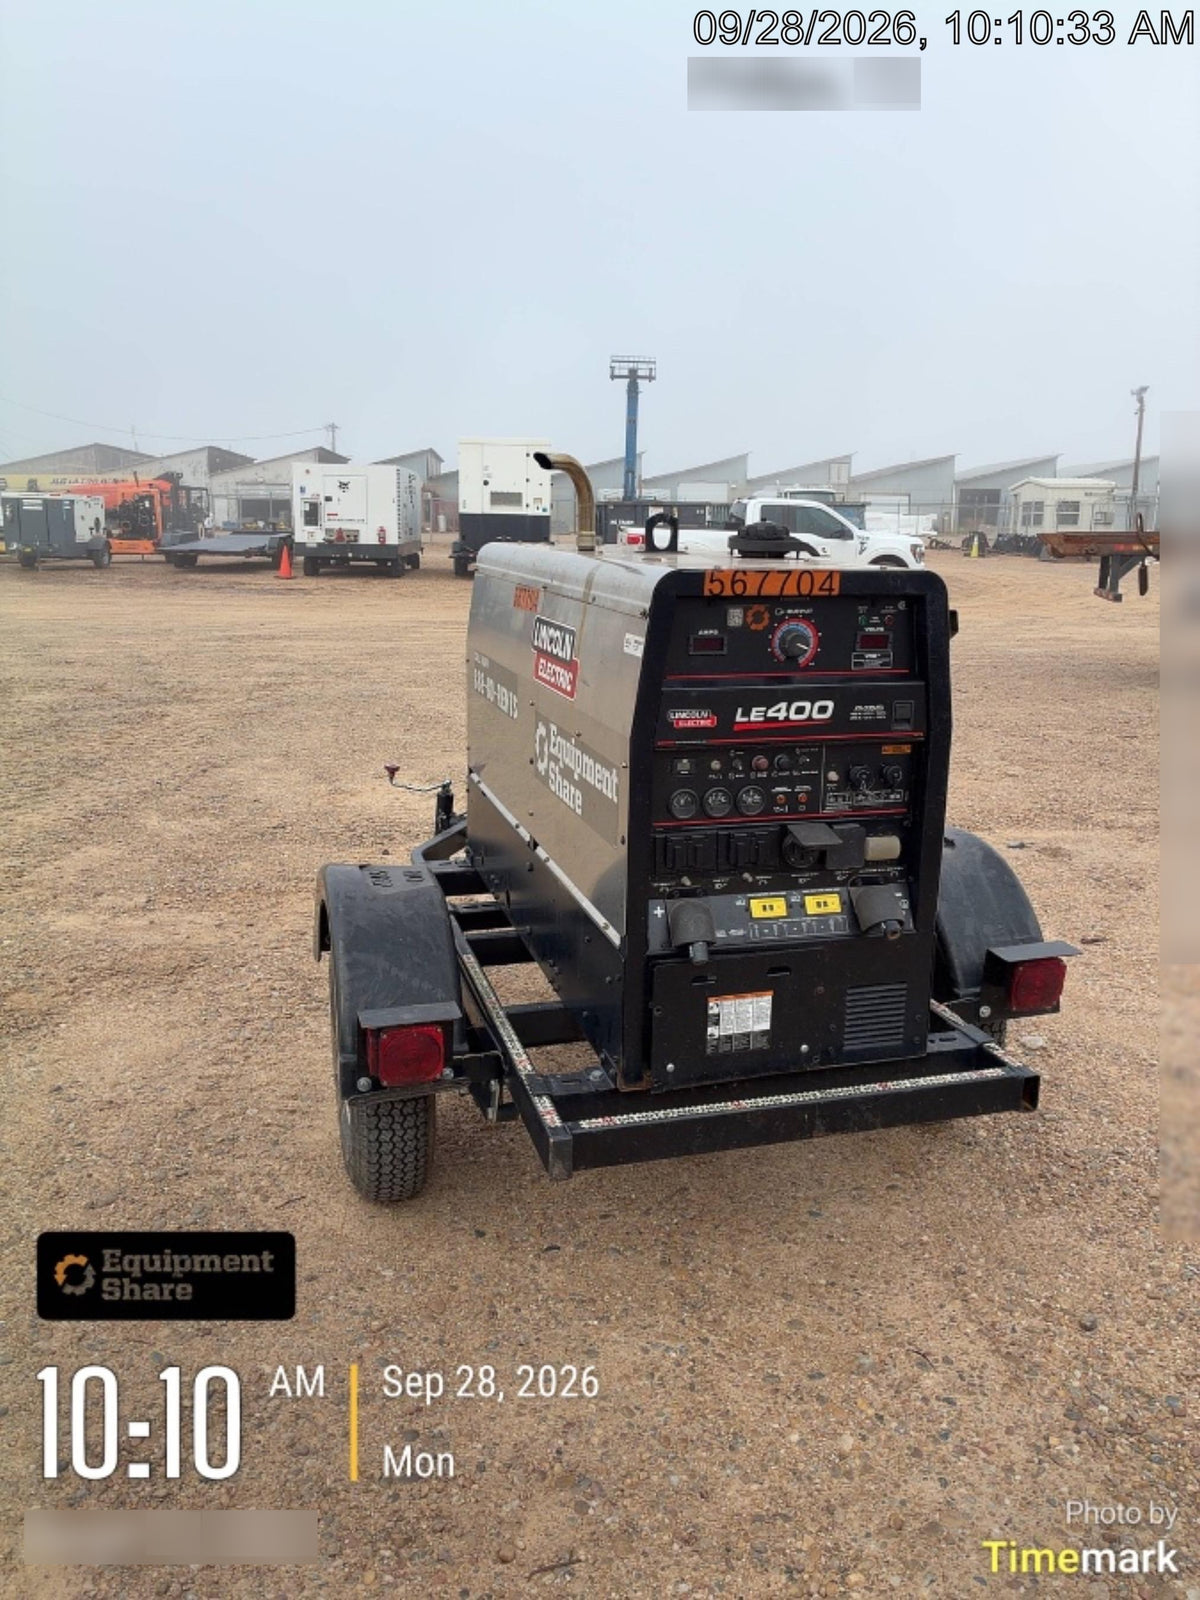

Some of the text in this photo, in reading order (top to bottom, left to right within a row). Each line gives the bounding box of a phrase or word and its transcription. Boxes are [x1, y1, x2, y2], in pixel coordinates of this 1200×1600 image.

[708, 570, 836, 596] 567704
[533, 620, 574, 661] LINCOLN
[537, 658, 574, 693] ELECTRIC
[669, 710, 710, 720] LINCOLN
[678, 719, 713, 727] ELECTRIC
[735, 700, 834, 723] LE400
[549, 722, 619, 804] Equipment
[548, 762, 583, 817] Share
